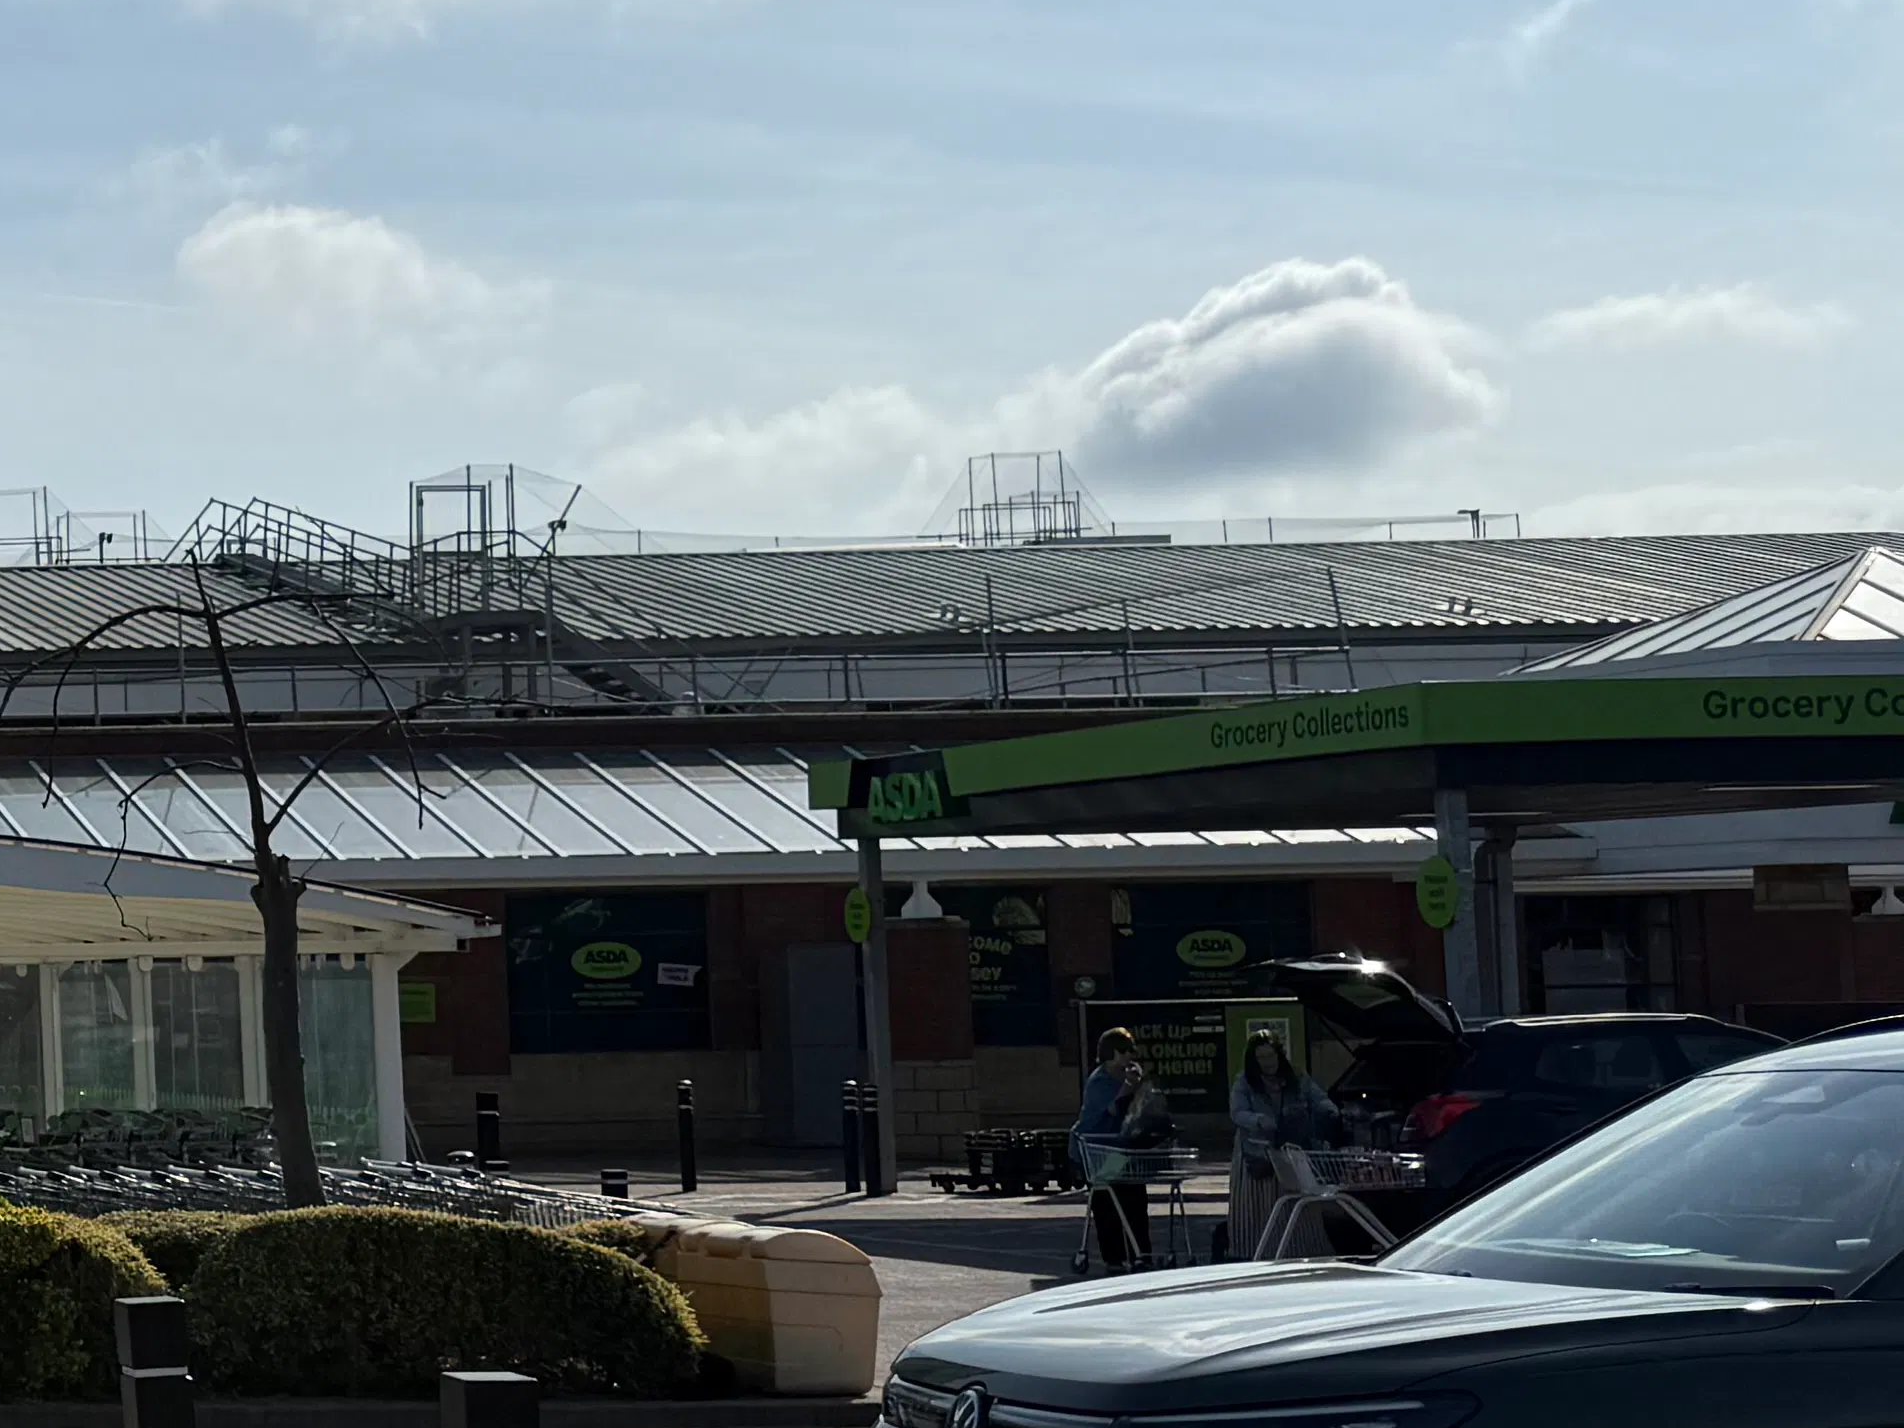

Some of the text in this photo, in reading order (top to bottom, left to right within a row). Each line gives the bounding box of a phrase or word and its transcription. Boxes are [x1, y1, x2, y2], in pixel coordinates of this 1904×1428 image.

[1703, 690, 1854, 724] Grocery
[1211, 700, 1410, 749] Grocery Collections
[868, 768, 943, 824] ASDA
[584, 950, 630, 964] ASDA
[1188, 939, 1233, 953] ASDA
